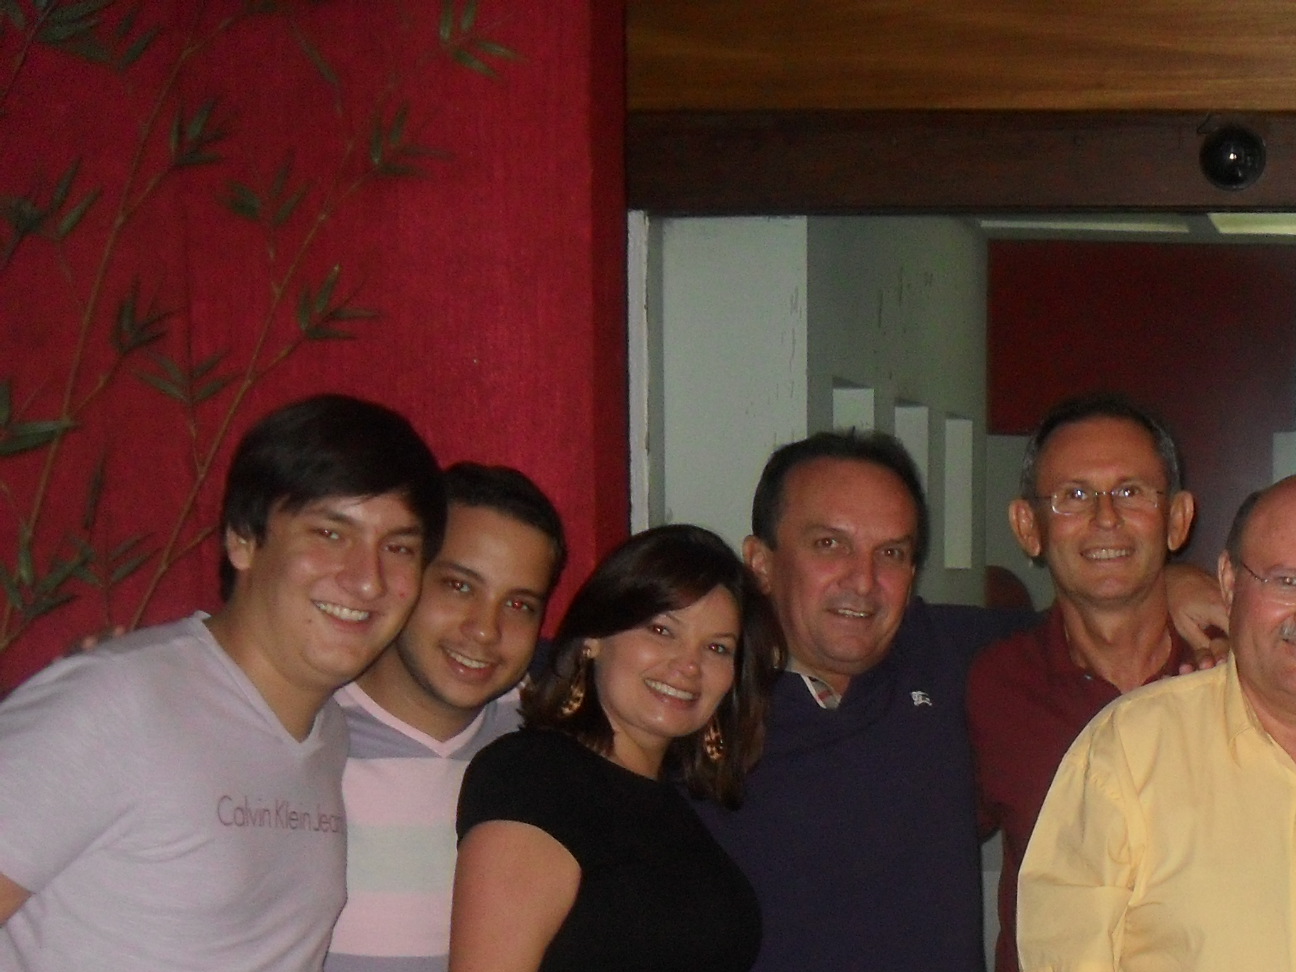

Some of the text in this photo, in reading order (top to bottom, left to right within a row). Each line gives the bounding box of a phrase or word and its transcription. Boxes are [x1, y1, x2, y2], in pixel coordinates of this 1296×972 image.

[217, 795, 343, 833] Calvin Klein Jea
